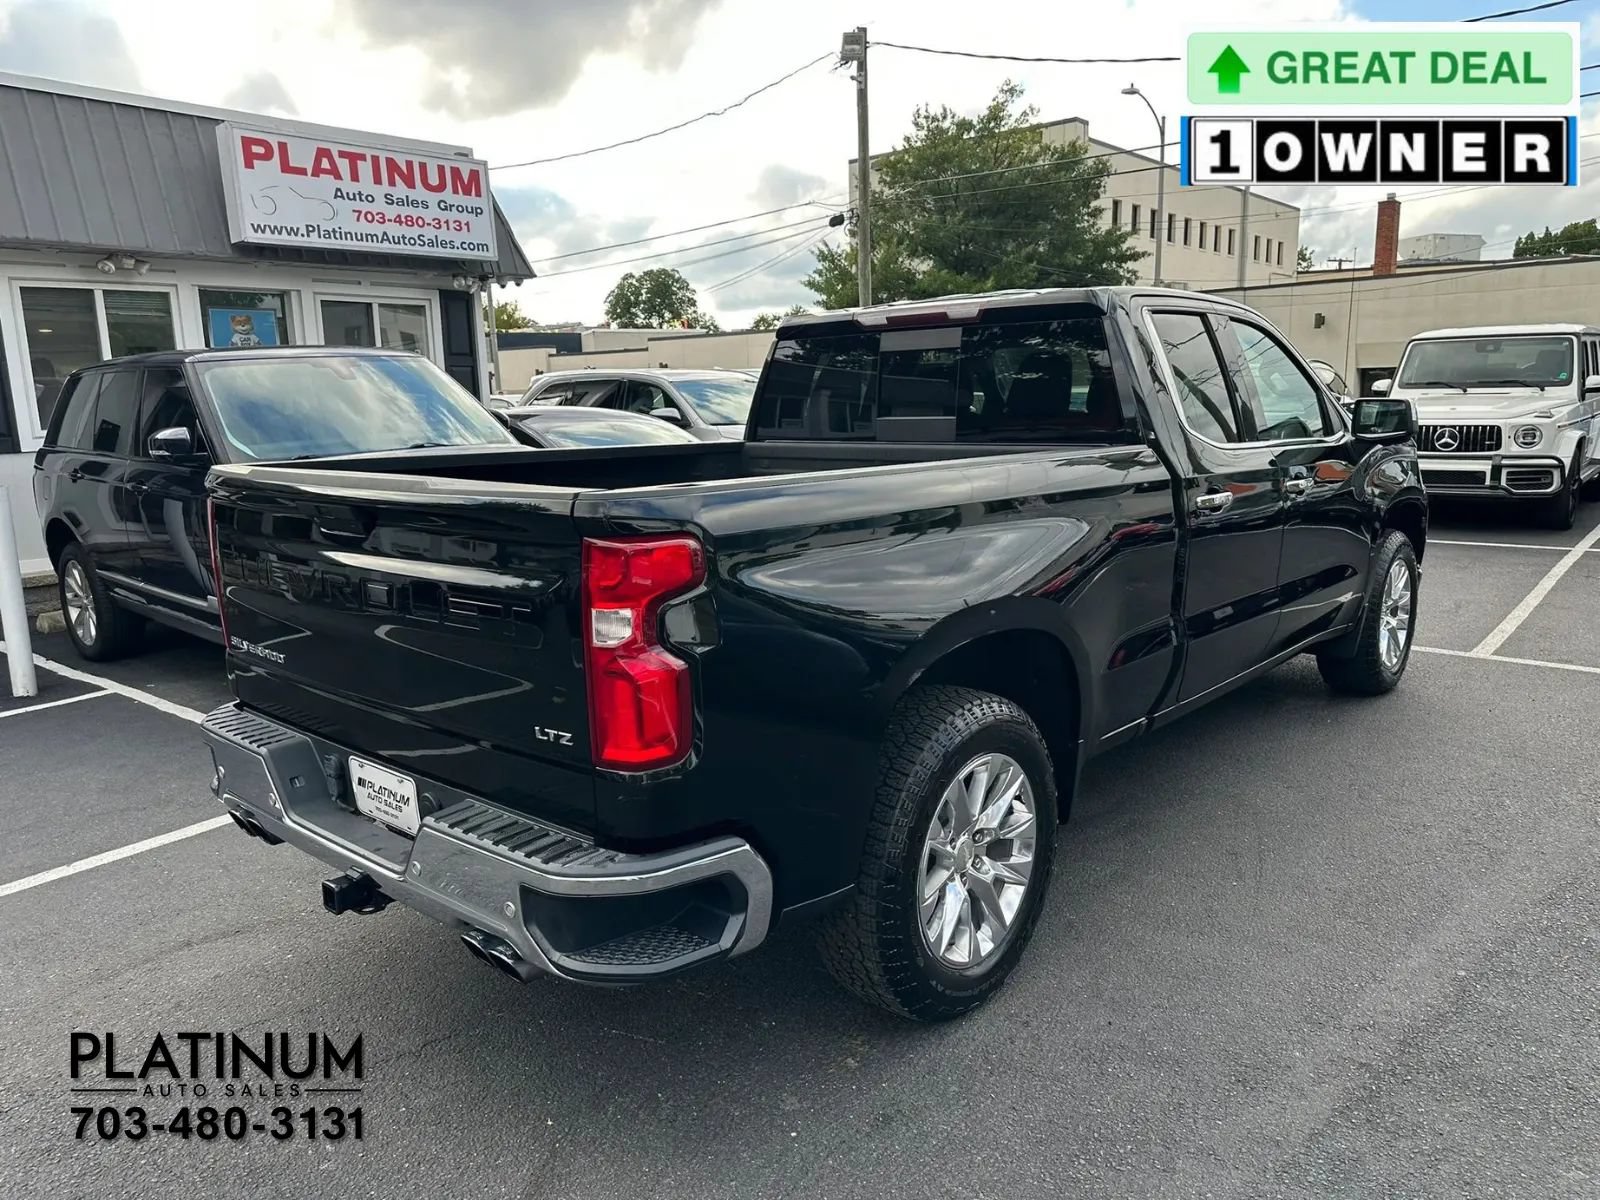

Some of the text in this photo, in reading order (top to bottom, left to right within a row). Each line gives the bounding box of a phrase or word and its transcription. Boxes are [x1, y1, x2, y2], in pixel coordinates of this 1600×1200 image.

[240, 135, 482, 197] PLATINUM
[333, 187, 484, 217] Auto Sales Group
[352, 209, 471, 233] 703-480-3131
[250, 222, 489, 252] www.PlatinumAutoSales.com
[534, 726, 574, 746] LTZ
[366, 780, 410, 807] PLATINUM
[367, 792, 384, 804] AUTO
[383, 799, 403, 813] SALES
